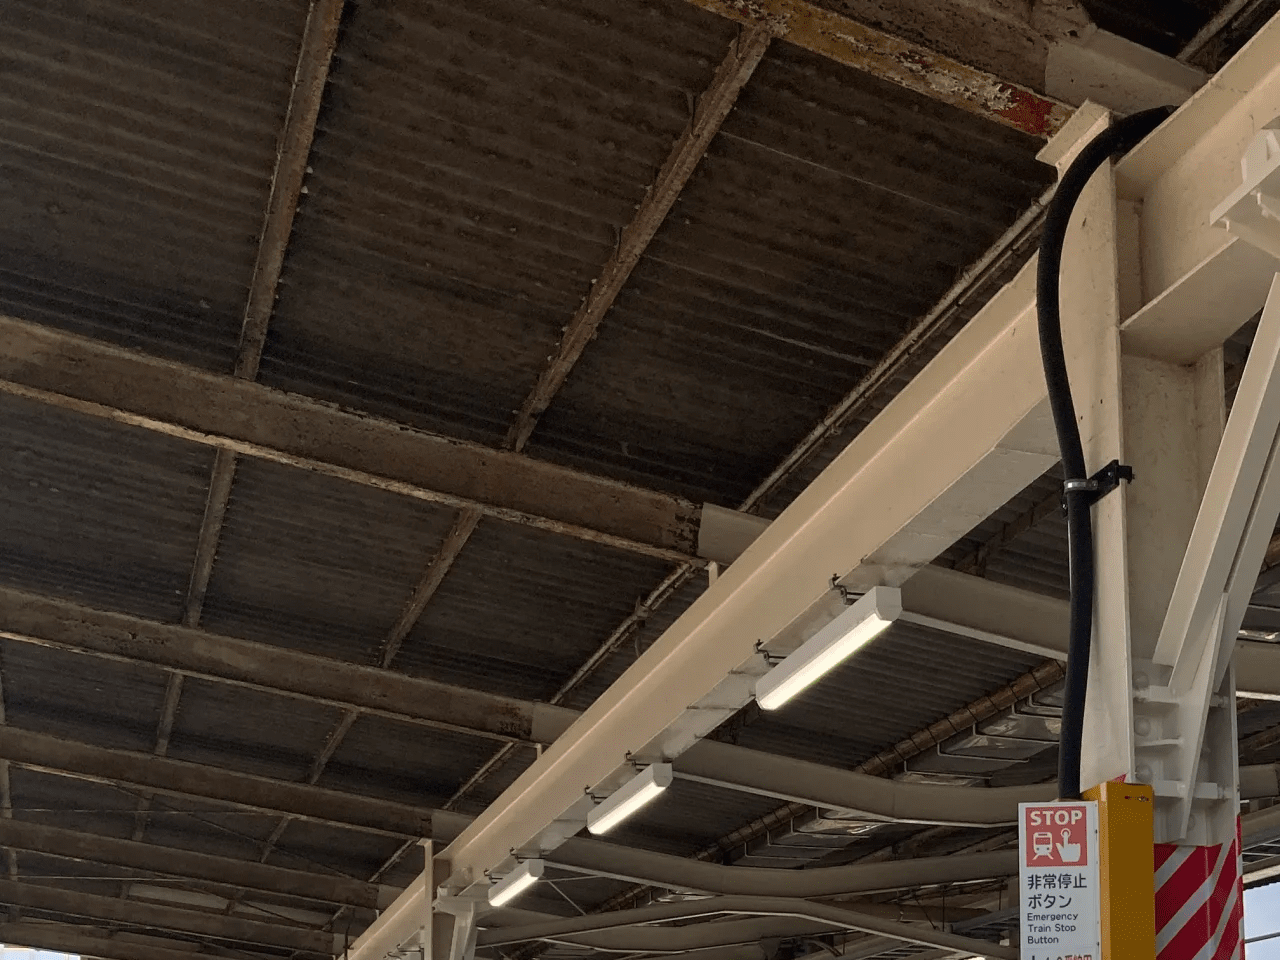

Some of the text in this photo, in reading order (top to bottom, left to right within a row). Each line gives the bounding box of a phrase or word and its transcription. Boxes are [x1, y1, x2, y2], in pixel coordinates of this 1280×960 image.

[1030, 810, 1082, 826] STOP
[1027, 873, 1087, 890] 非常停止
[1028, 894, 1072, 909] ボタン
[1027, 912, 1079, 922] Emergency
[1028, 923, 1076, 934] Train Stop
[1027, 935, 1059, 945] Button
